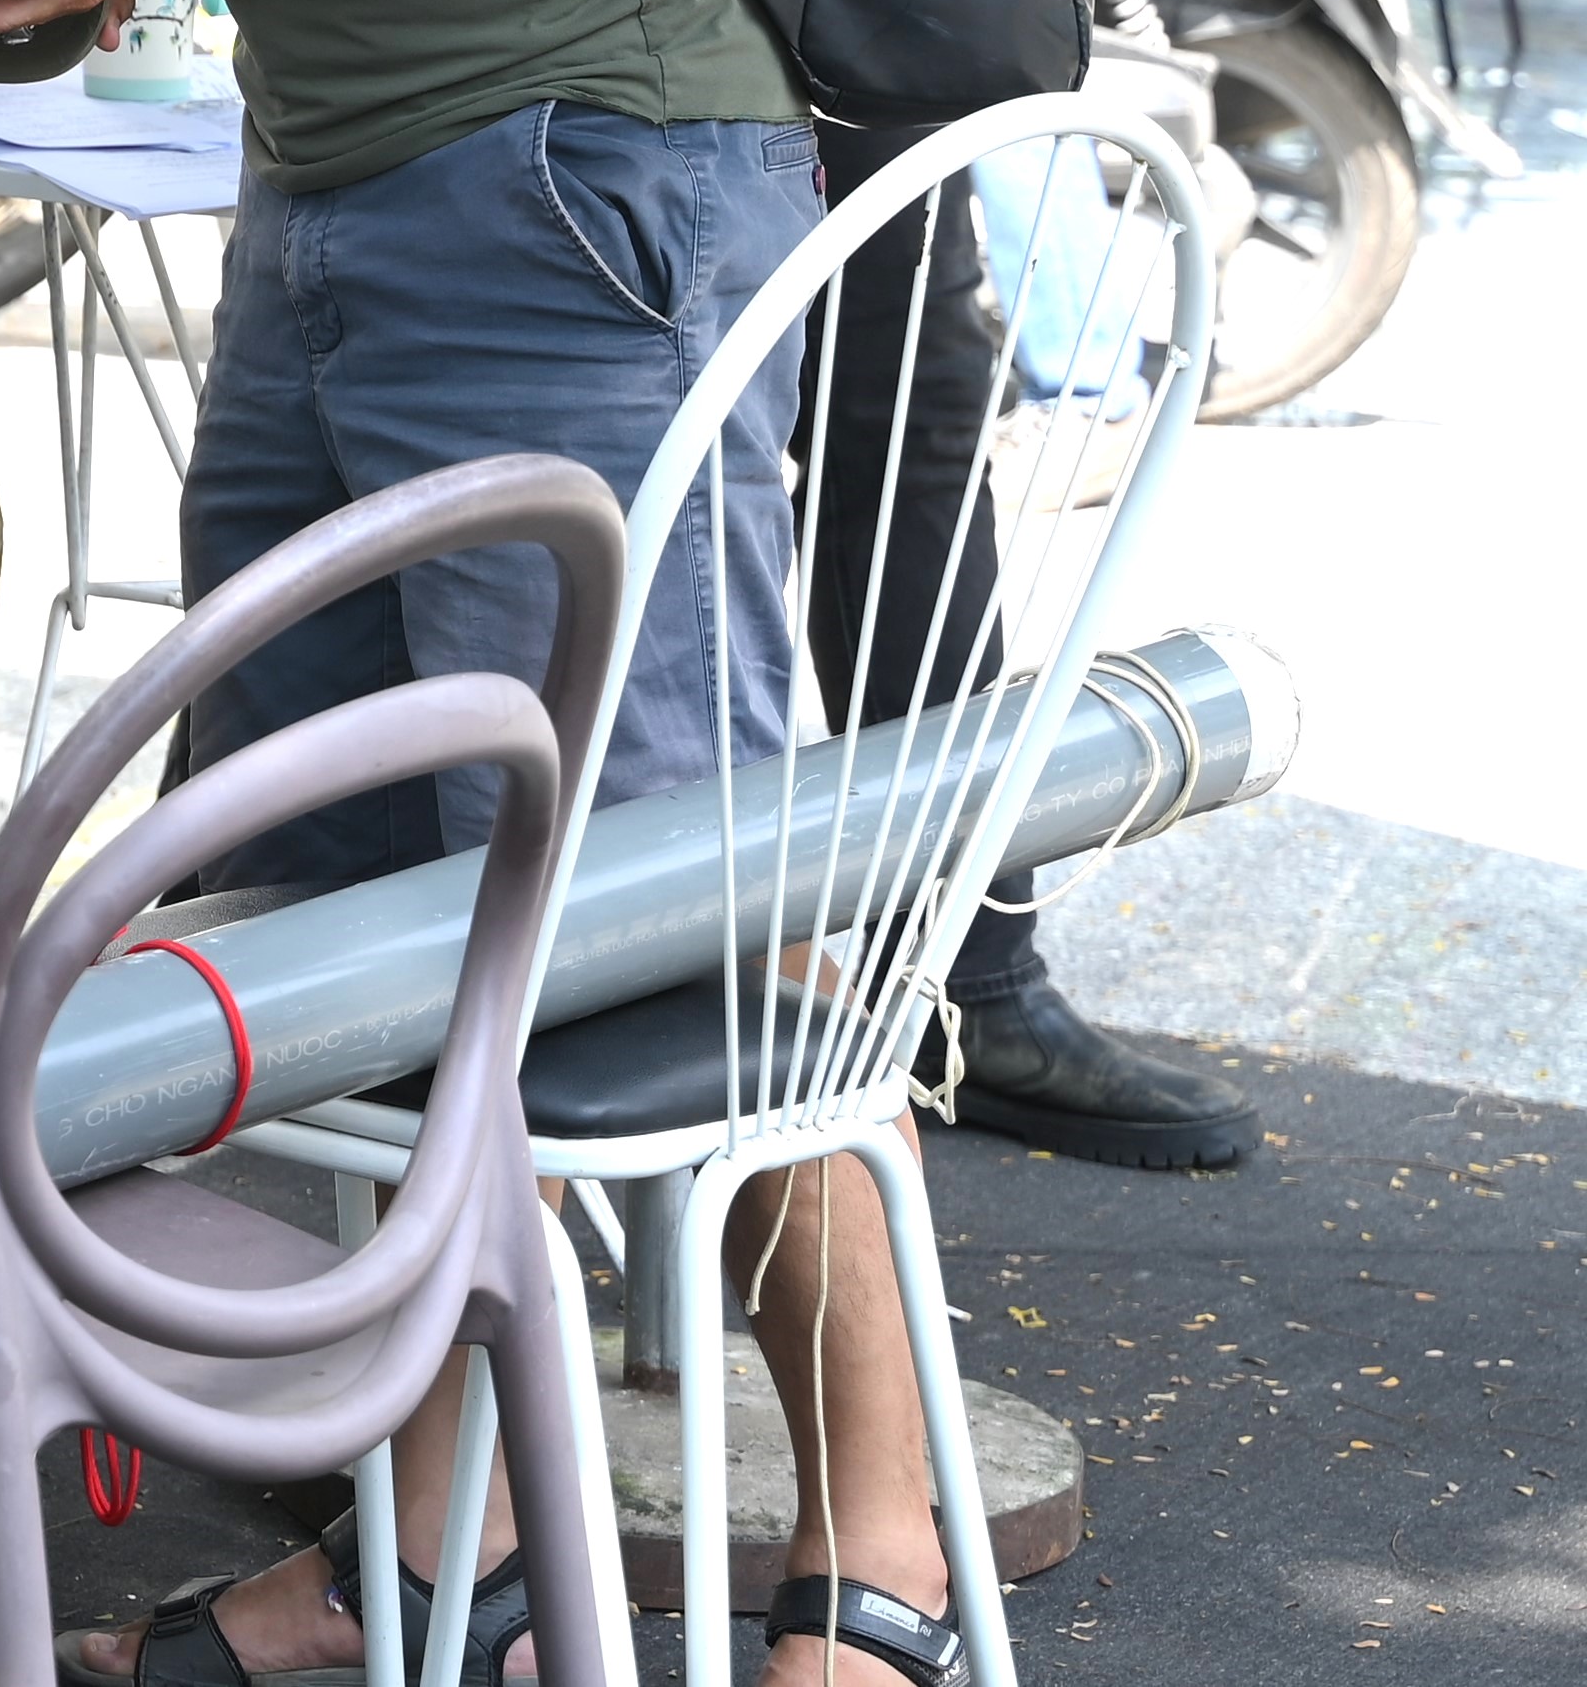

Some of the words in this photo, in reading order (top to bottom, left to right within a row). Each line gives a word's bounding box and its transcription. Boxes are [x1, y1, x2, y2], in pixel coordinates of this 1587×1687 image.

[1050, 789, 1082, 813] TY
[1092, 776, 1125, 800] CO
[85, 1093, 145, 1126] CHO
[158, 1066, 235, 1105] NGAN
[265, 1029, 342, 1069] NUOC
